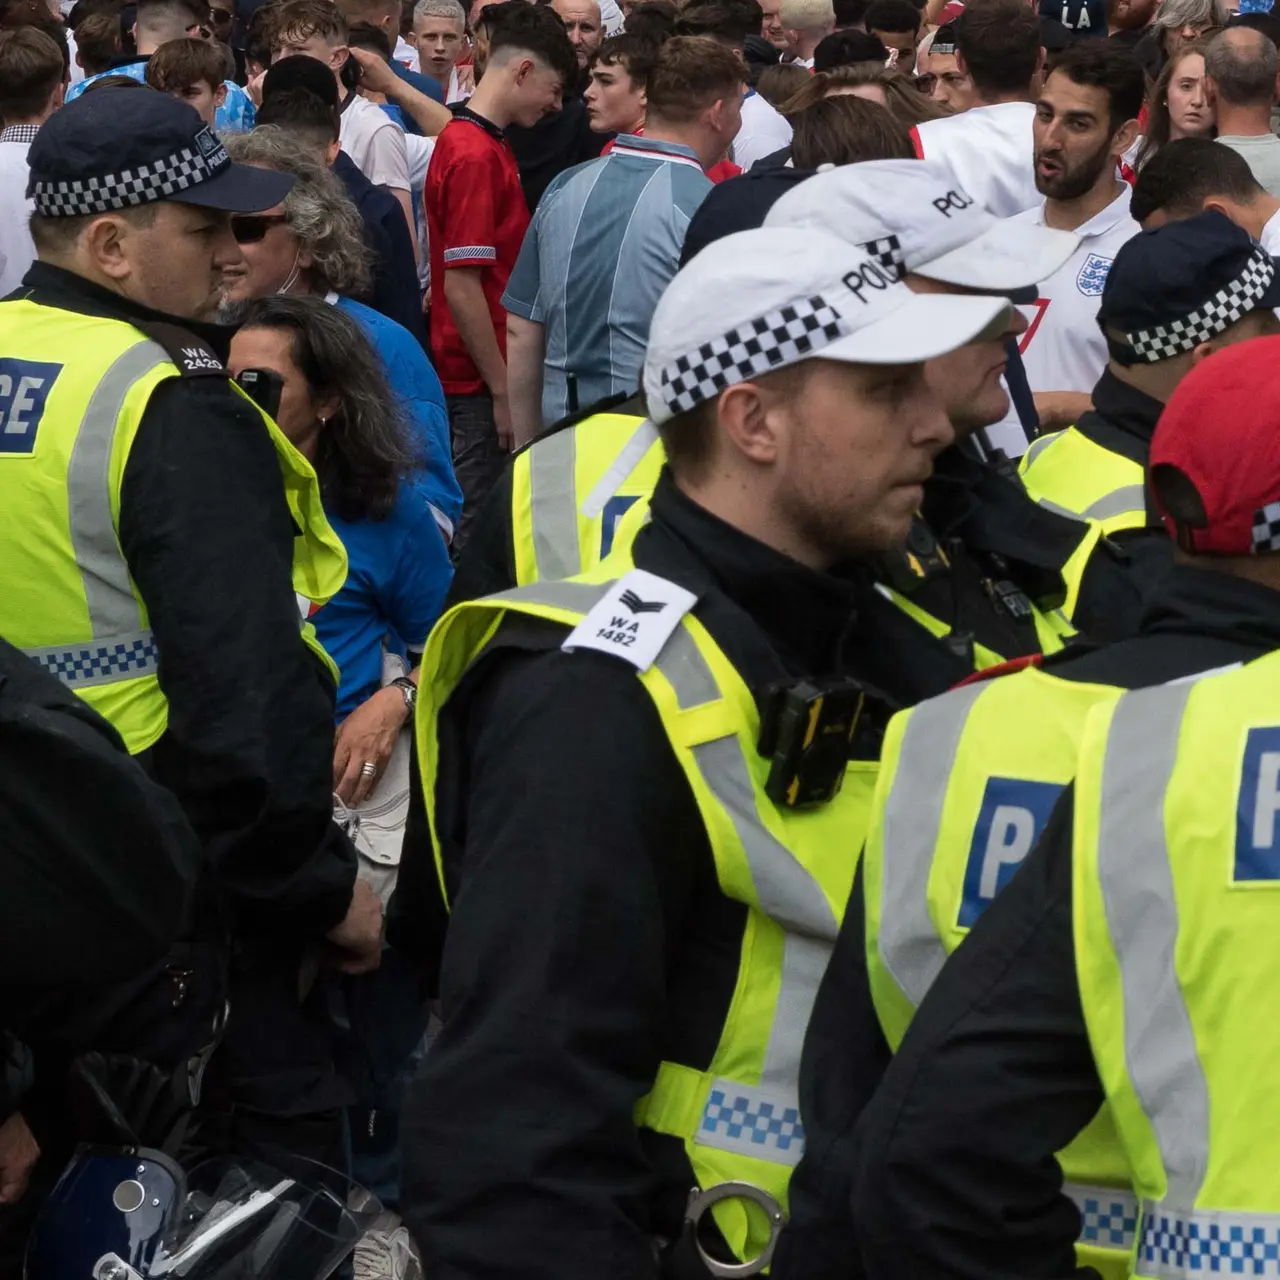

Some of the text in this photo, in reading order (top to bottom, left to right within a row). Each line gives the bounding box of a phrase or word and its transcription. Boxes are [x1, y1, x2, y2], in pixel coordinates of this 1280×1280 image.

[1061, 5, 1091, 29] LA
[181, 347, 209, 359] WA
[184, 358, 223, 371] 2420
[609, 616, 640, 634] WA
[596, 628, 637, 648] 1482
